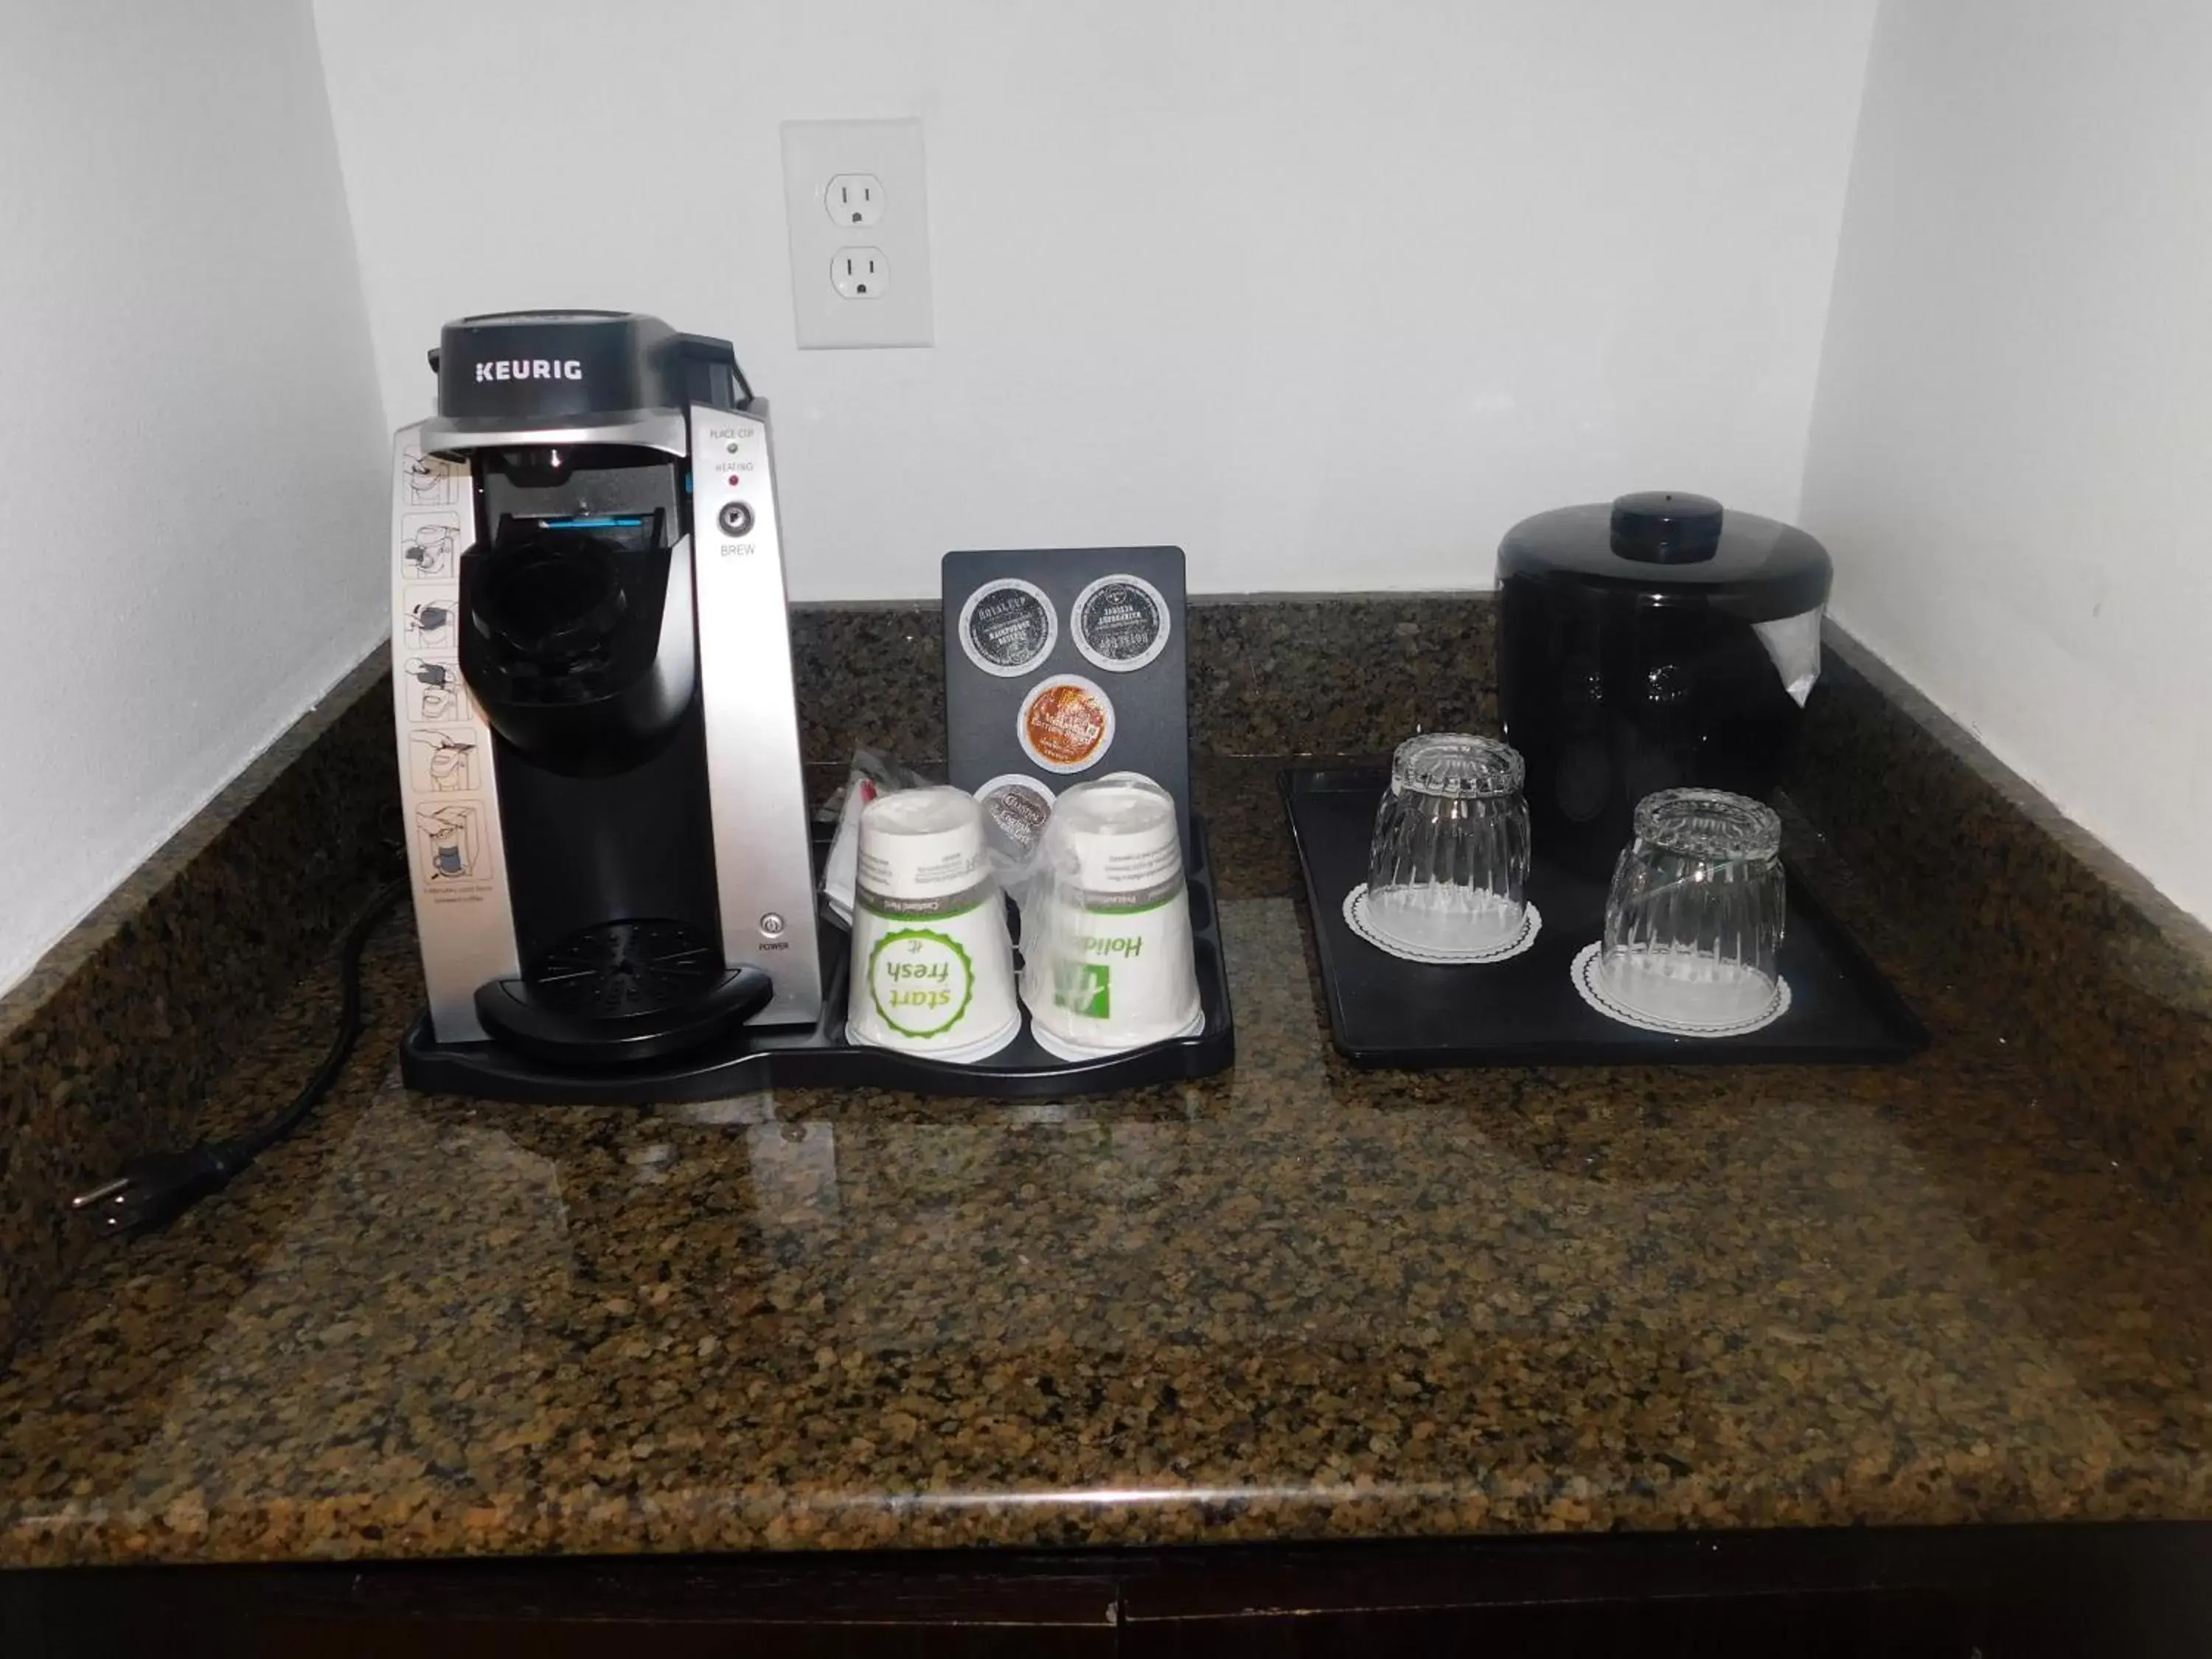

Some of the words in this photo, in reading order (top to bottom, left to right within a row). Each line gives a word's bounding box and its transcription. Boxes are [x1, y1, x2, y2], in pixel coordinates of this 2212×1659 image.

[476, 359, 582, 383] KEURIG
[710, 428, 735, 439] PLACE
[737, 428, 754, 439] CUP
[715, 462, 754, 473] HEATING
[720, 543, 755, 557] BREW
[1071, 935, 1143, 959] Holid
[887, 961, 949, 984] fresh
[888, 989, 951, 1011] start
